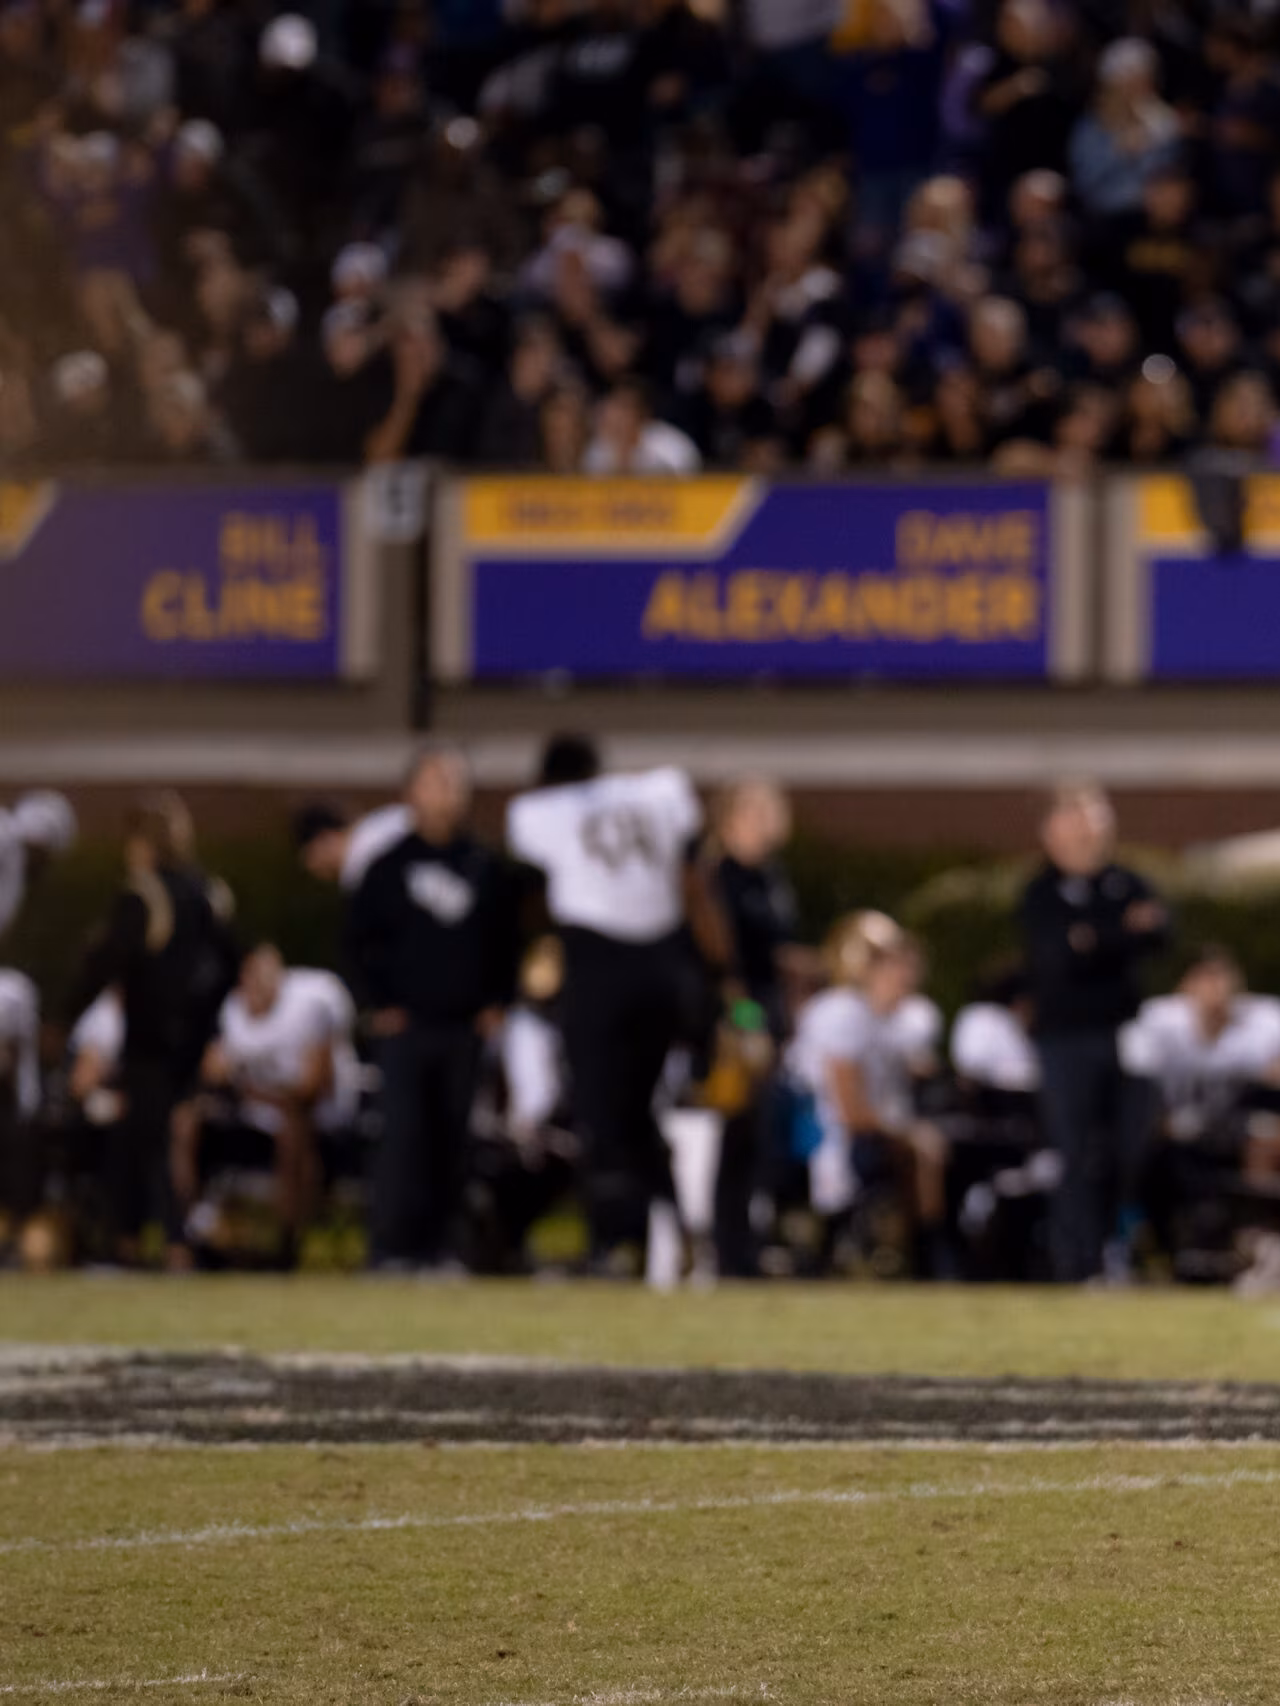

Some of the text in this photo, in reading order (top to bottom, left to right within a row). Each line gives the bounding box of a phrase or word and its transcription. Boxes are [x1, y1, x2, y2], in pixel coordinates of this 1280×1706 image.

[220, 513, 320, 566] BILL
[897, 511, 1037, 563] DAVE
[143, 569, 325, 640] CLINE
[642, 570, 1039, 642] ALEXANDER
